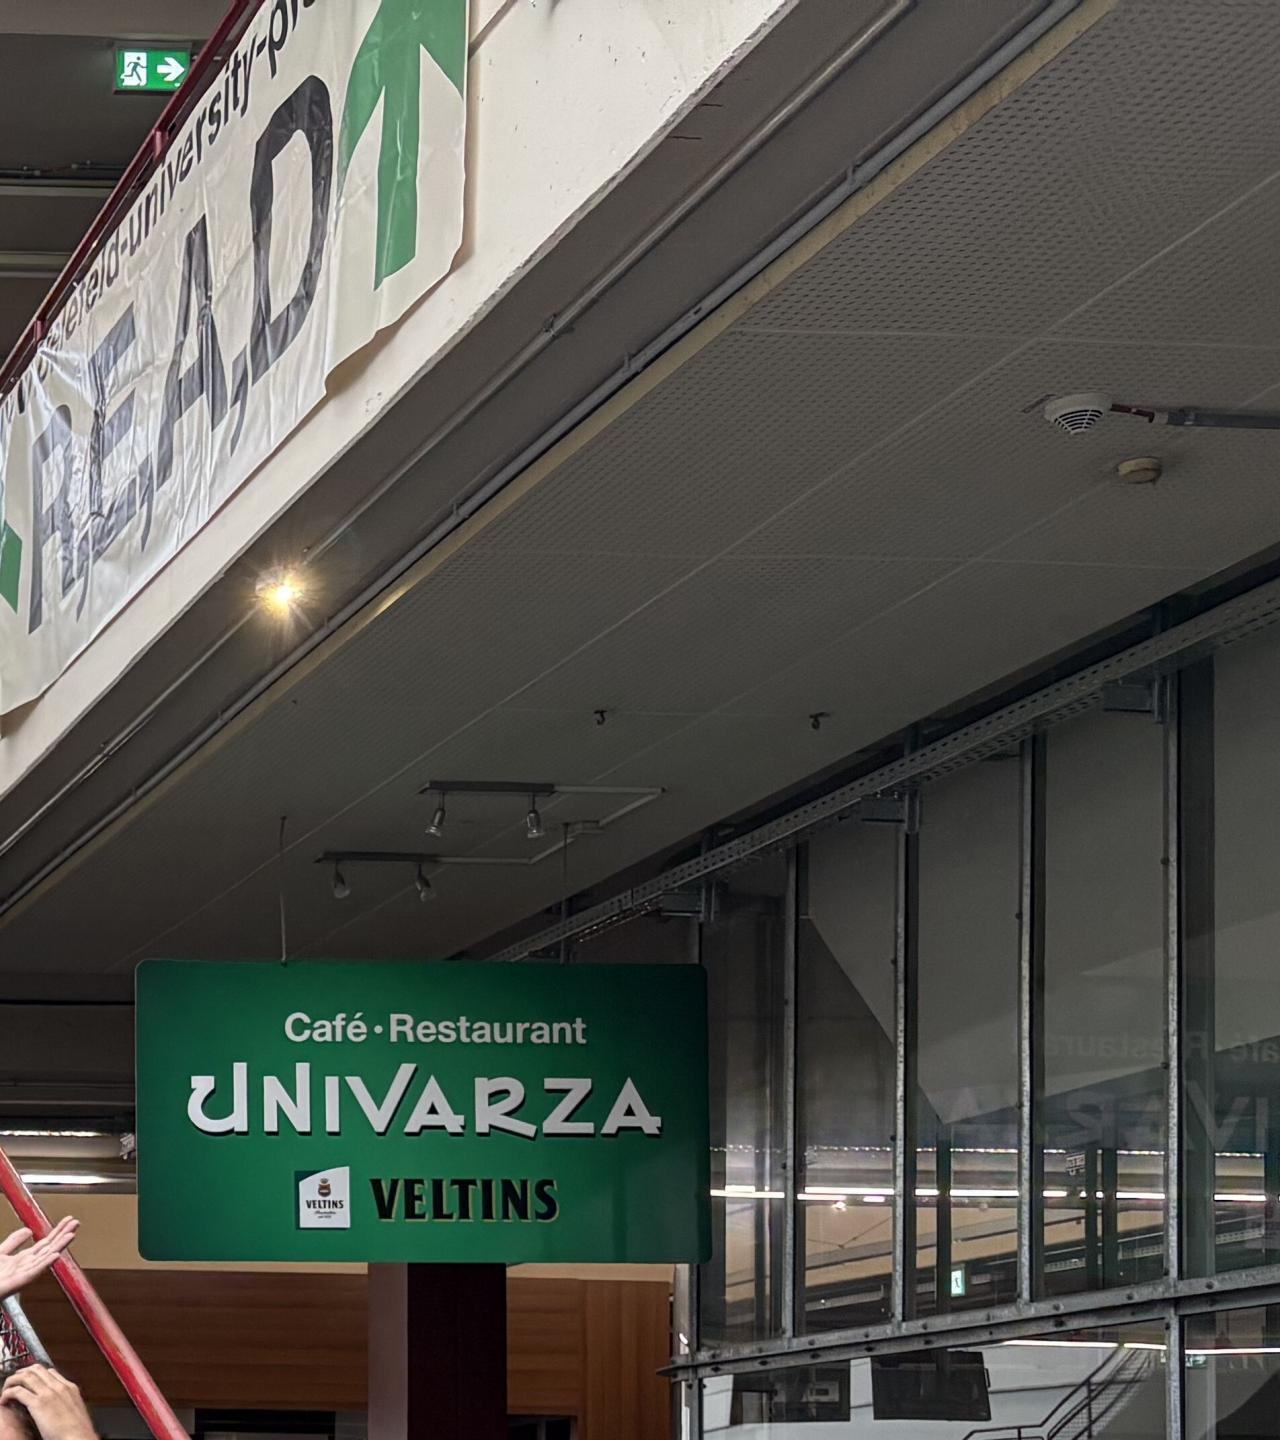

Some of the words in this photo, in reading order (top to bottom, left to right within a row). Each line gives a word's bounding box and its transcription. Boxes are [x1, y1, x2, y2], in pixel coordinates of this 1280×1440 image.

[285, 1012, 367, 1042] Café
[390, 1013, 586, 1044] Restaurant
[306, 1199, 344, 1209] VELTINS
[370, 1178, 559, 1223] VELTINS
